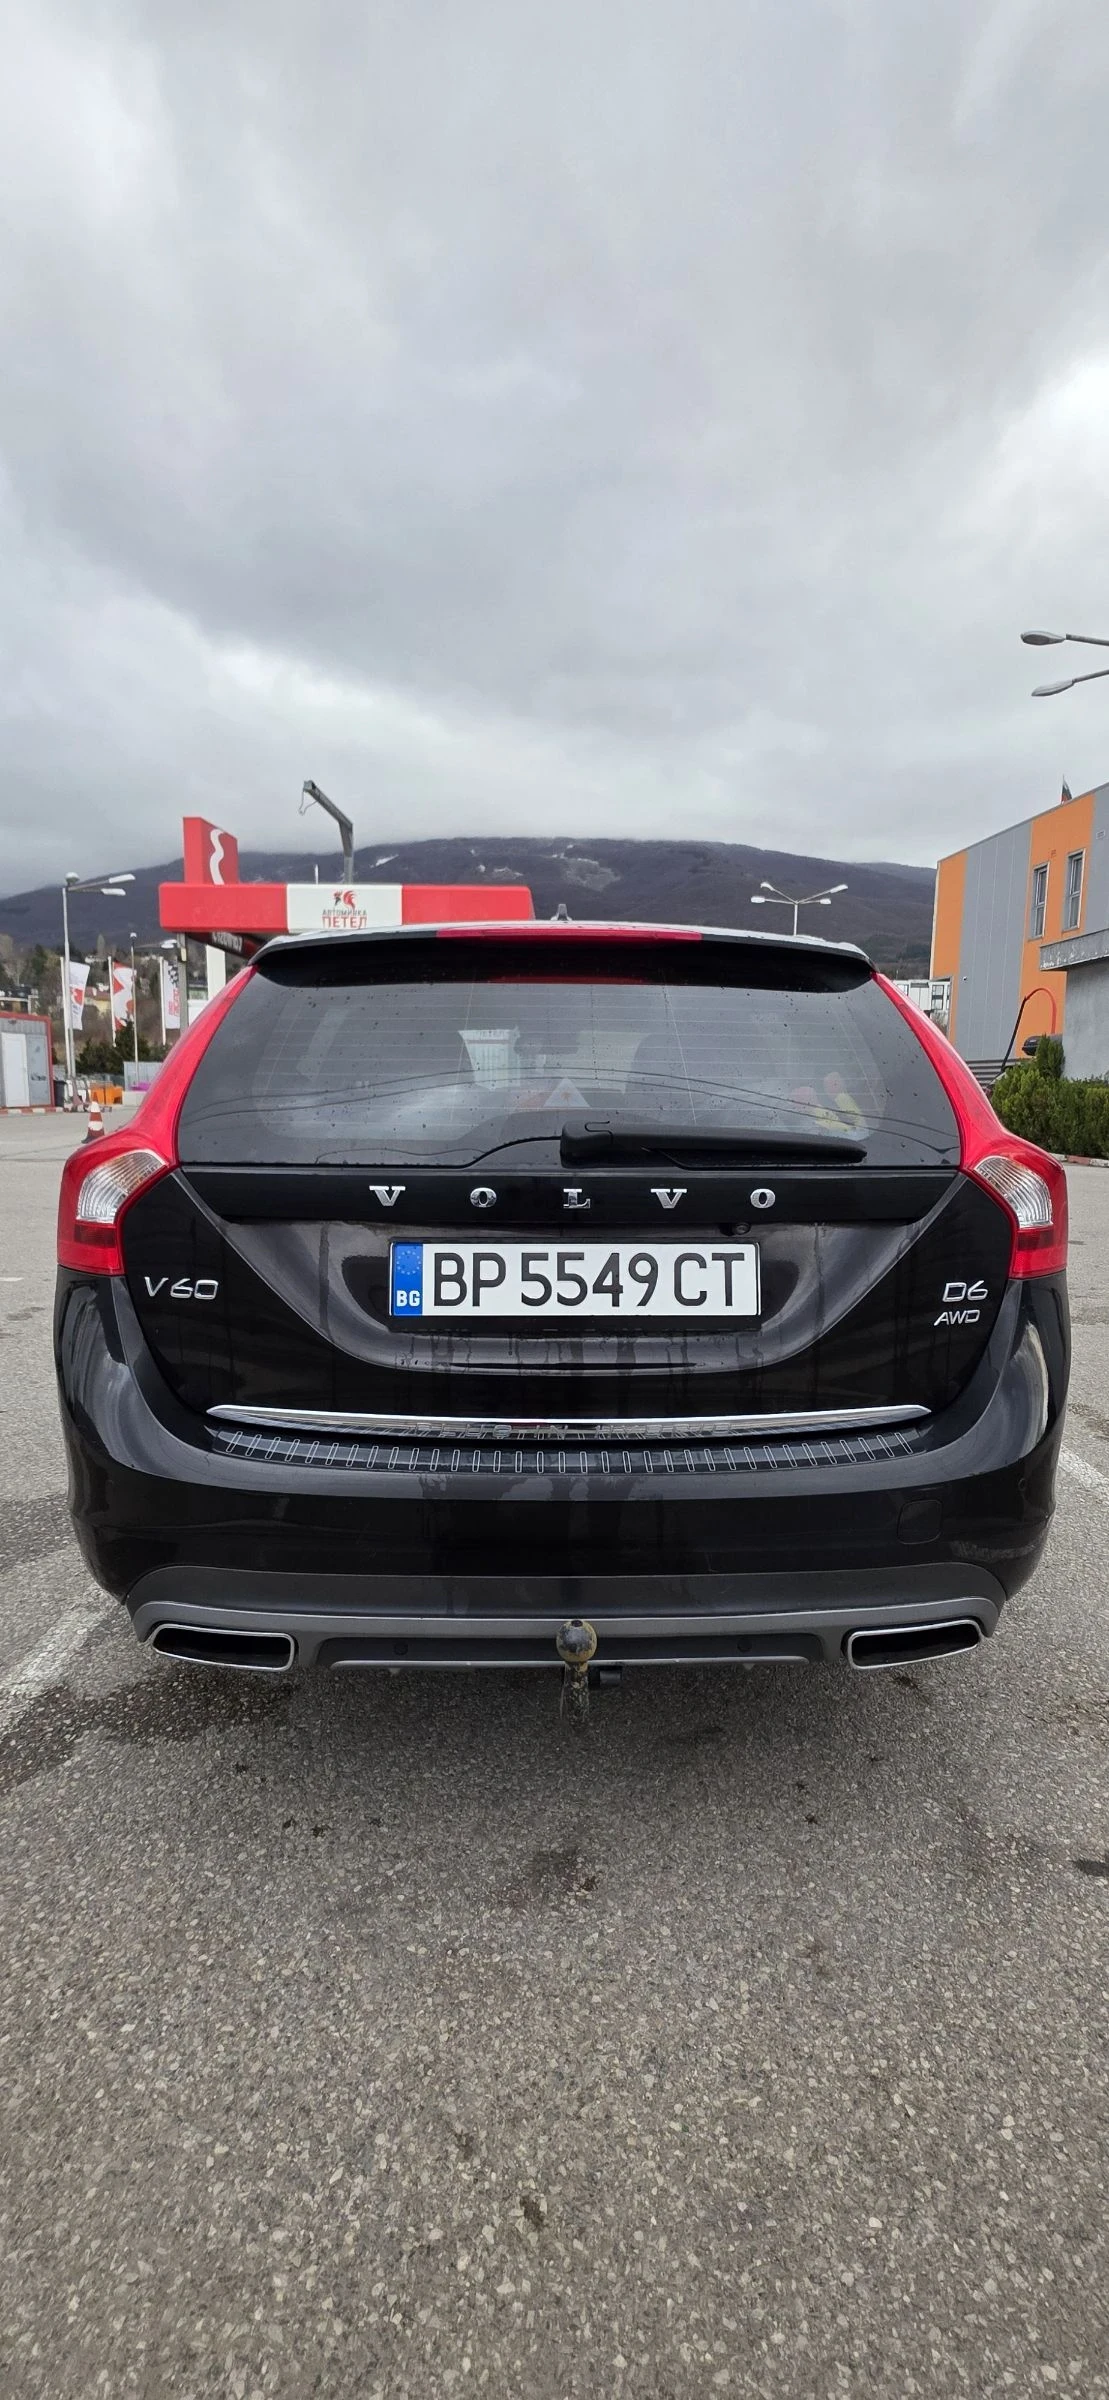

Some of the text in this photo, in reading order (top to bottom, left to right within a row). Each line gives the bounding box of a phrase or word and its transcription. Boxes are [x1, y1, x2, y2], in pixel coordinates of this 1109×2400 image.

[322, 916, 367, 929] ПЕТЕЛ
[369, 1185, 776, 1209] VOLVO
[144, 1276, 219, 1300] V60
[433, 1252, 745, 1307] BP 5549 CT
[396, 1290, 421, 1307] BG
[942, 1280, 989, 1302] D6
[933, 1309, 981, 1326] AWD
